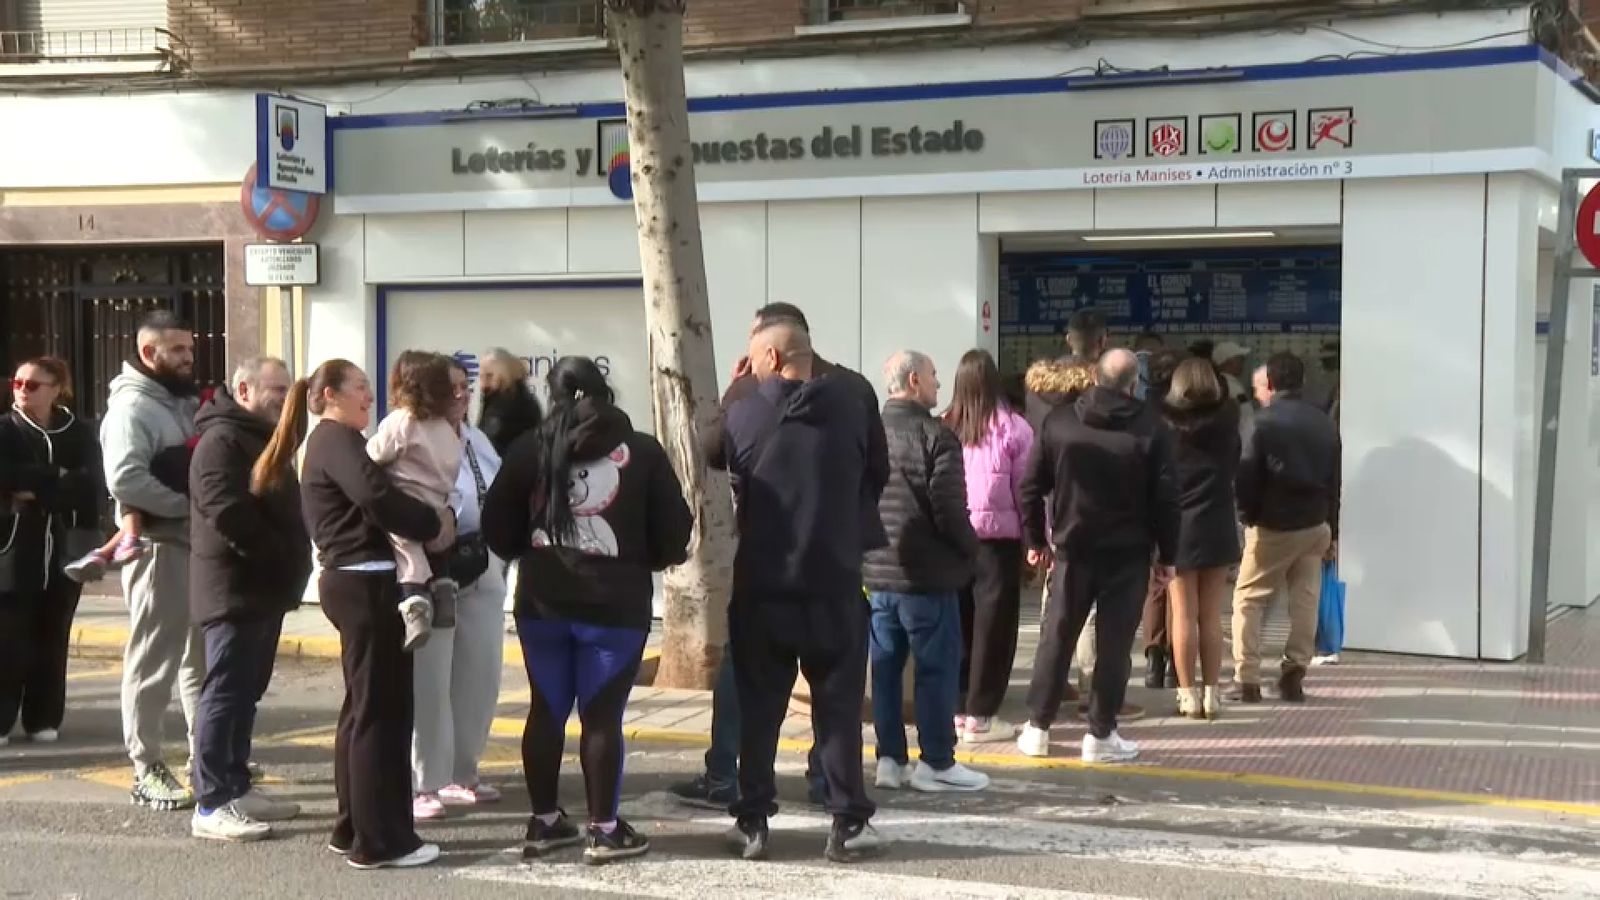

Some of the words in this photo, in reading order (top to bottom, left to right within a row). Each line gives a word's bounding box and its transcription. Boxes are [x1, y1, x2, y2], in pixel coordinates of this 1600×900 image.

[452, 141, 565, 174] Loterías
[574, 148, 593, 176] y
[811, 125, 862, 158] del
[871, 119, 984, 155] Estado
[1136, 167, 1193, 182] Manises
[1208, 163, 1318, 179] Administración
[1344, 161, 1353, 174] 3
